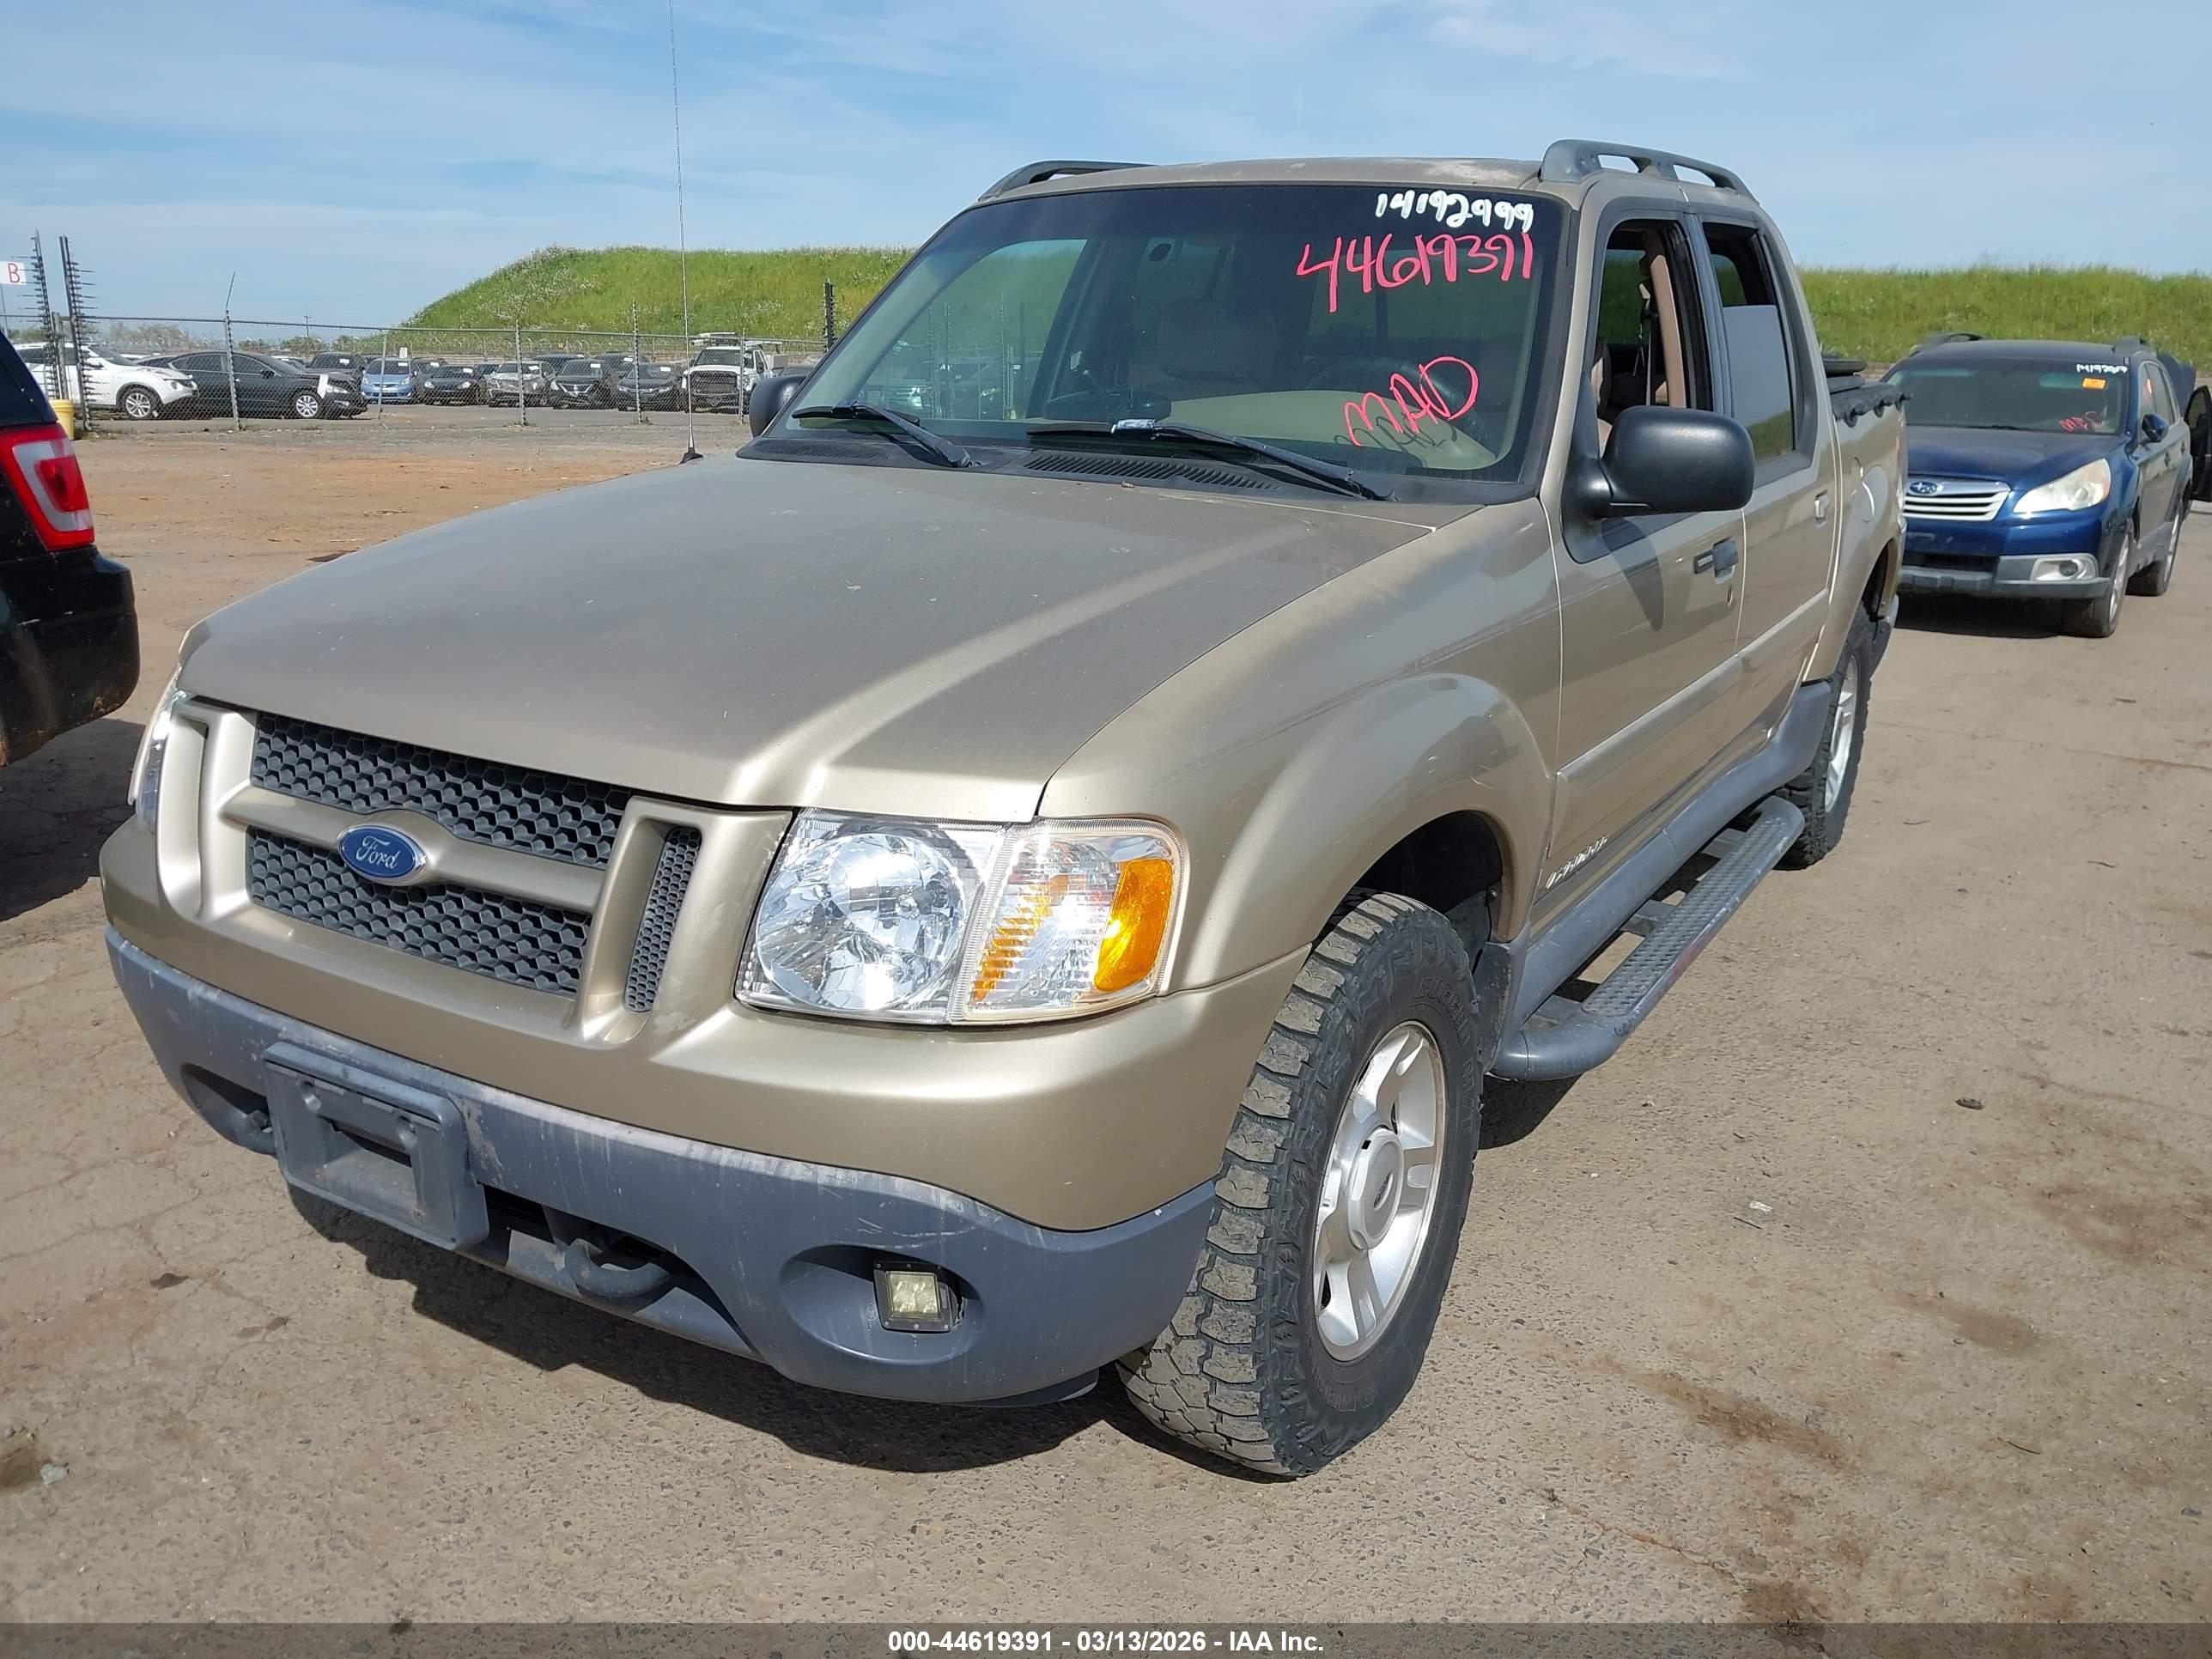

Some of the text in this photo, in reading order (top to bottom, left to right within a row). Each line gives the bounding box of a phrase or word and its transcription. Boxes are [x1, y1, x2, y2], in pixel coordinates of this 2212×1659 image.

[1376, 190, 1534, 233] 14192999
[8, 263, 20, 283] B
[1296, 233, 1534, 313] 44619391
[356, 836, 401, 869] Ford
